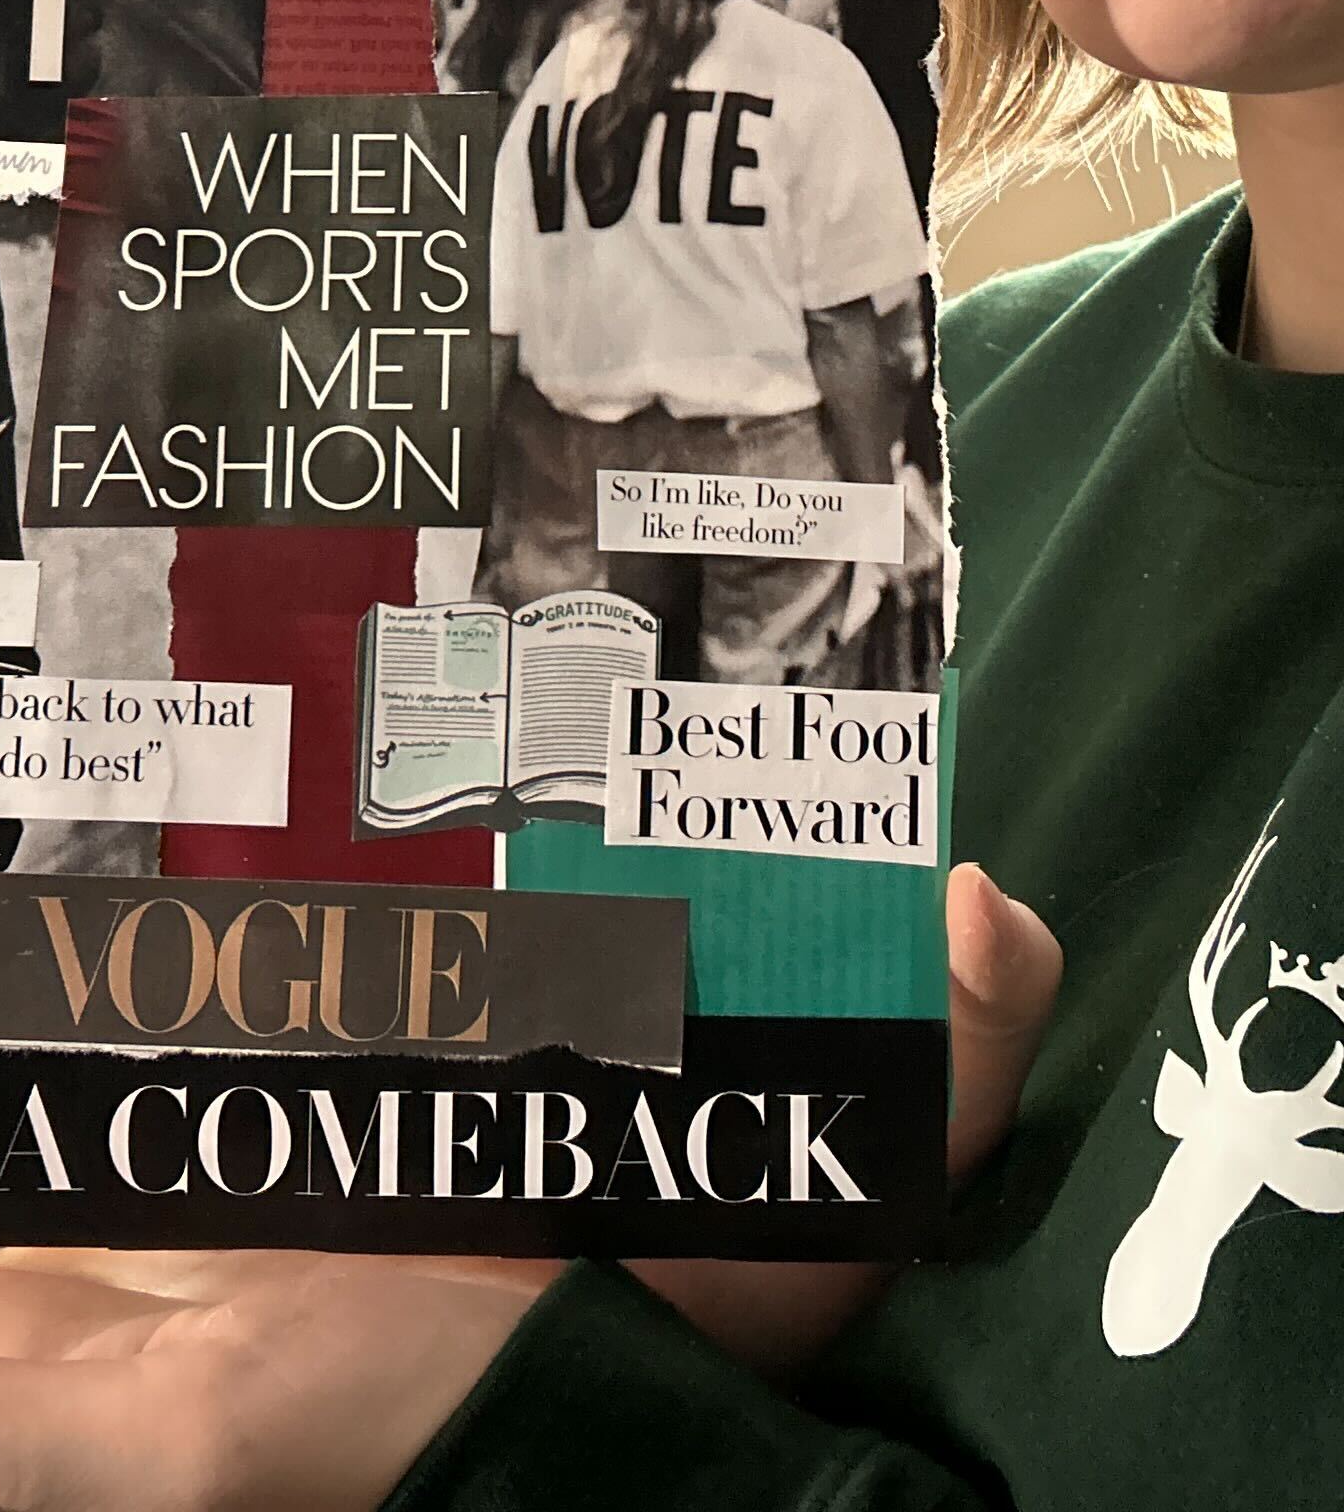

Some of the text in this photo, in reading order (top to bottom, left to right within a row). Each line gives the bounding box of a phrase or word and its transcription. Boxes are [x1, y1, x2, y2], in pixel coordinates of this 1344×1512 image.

[181, 131, 467, 216] WHEN
[528, 90, 775, 233] VOTE
[118, 226, 469, 313] SPORTS
[279, 325, 470, 411] MET
[50, 423, 461, 511] FASHION
[610, 475, 642, 503] So
[697, 479, 745, 509] like,
[754, 482, 792, 510] Do
[799, 492, 843, 520] you
[642, 512, 684, 540] like
[544, 601, 634, 622] GRATITUDE
[104, 688, 143, 724] to
[152, 683, 256, 728] what
[621, 686, 938, 766] Best Foot
[0, 735, 49, 780] do
[630, 767, 924, 848] Forward
[29, 895, 490, 1043] VOGUE
[109, 1084, 883, 1205] COMEBACK
